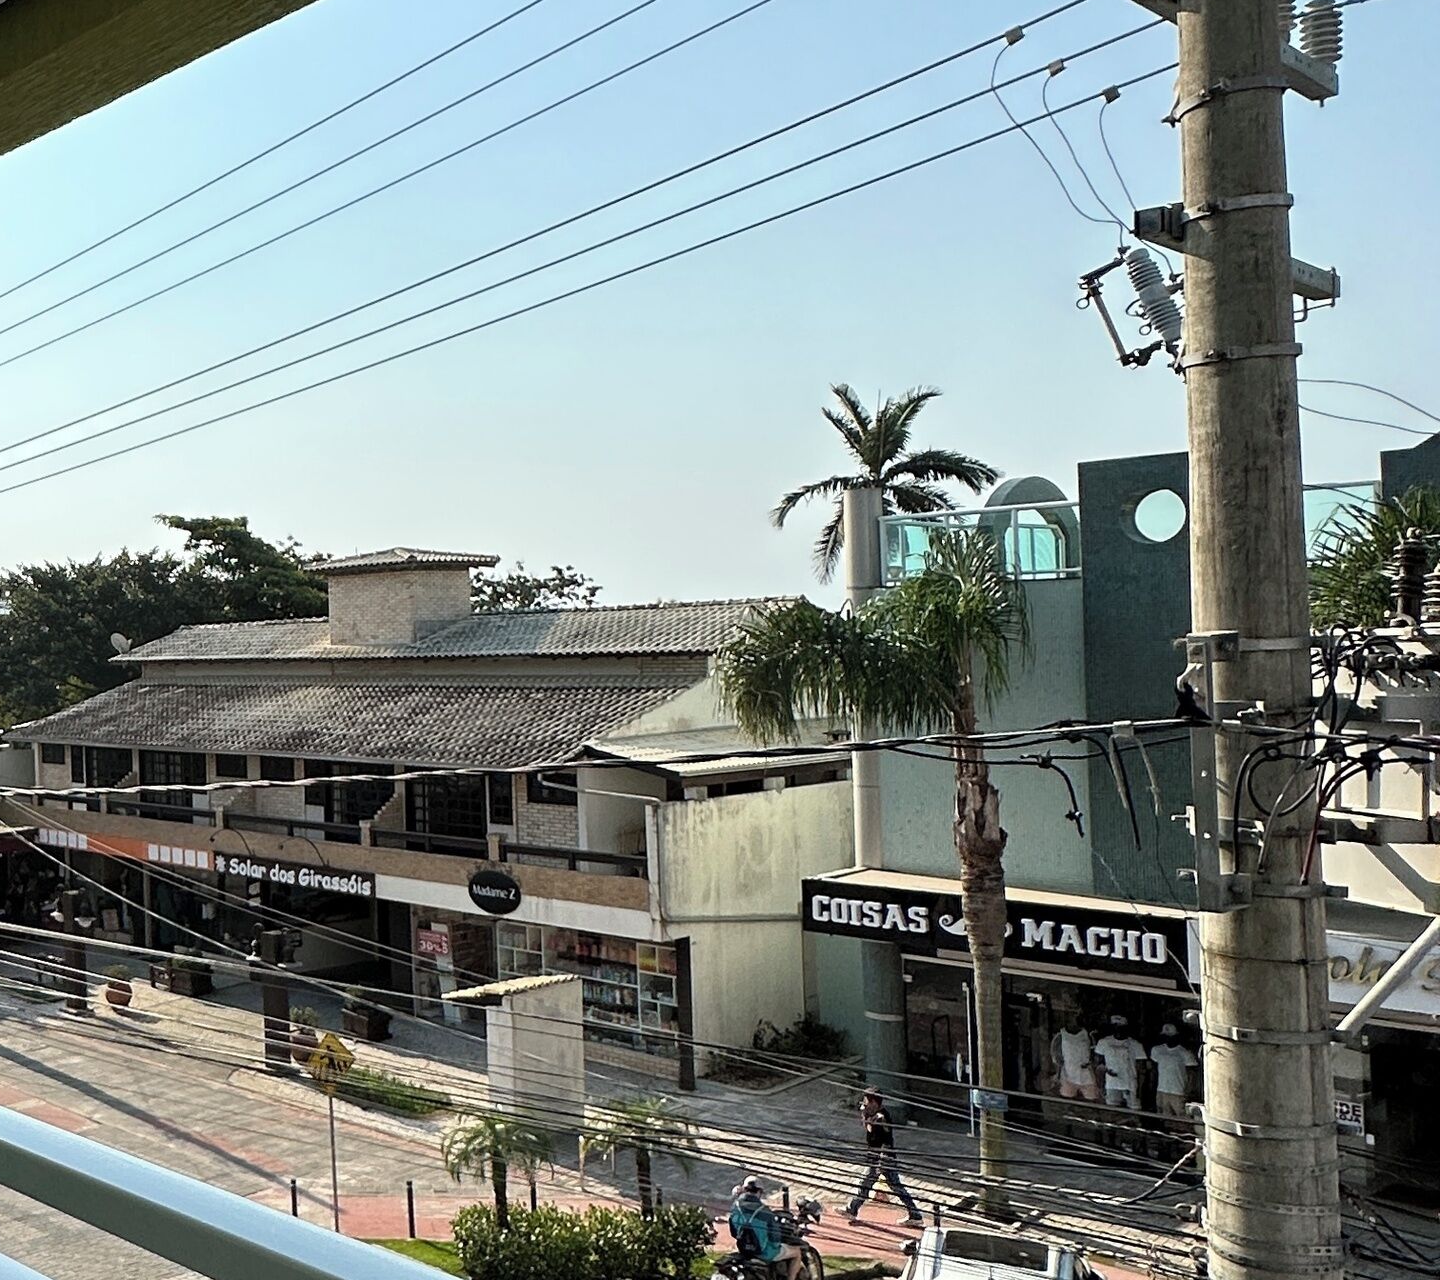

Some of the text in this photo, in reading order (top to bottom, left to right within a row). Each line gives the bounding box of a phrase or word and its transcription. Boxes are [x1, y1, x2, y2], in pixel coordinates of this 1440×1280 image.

[229, 858, 372, 896] Solar dos Girassóis
[811, 894, 1168, 964] COISAS MACHO
[1338, 1114, 1362, 1124] OJA
